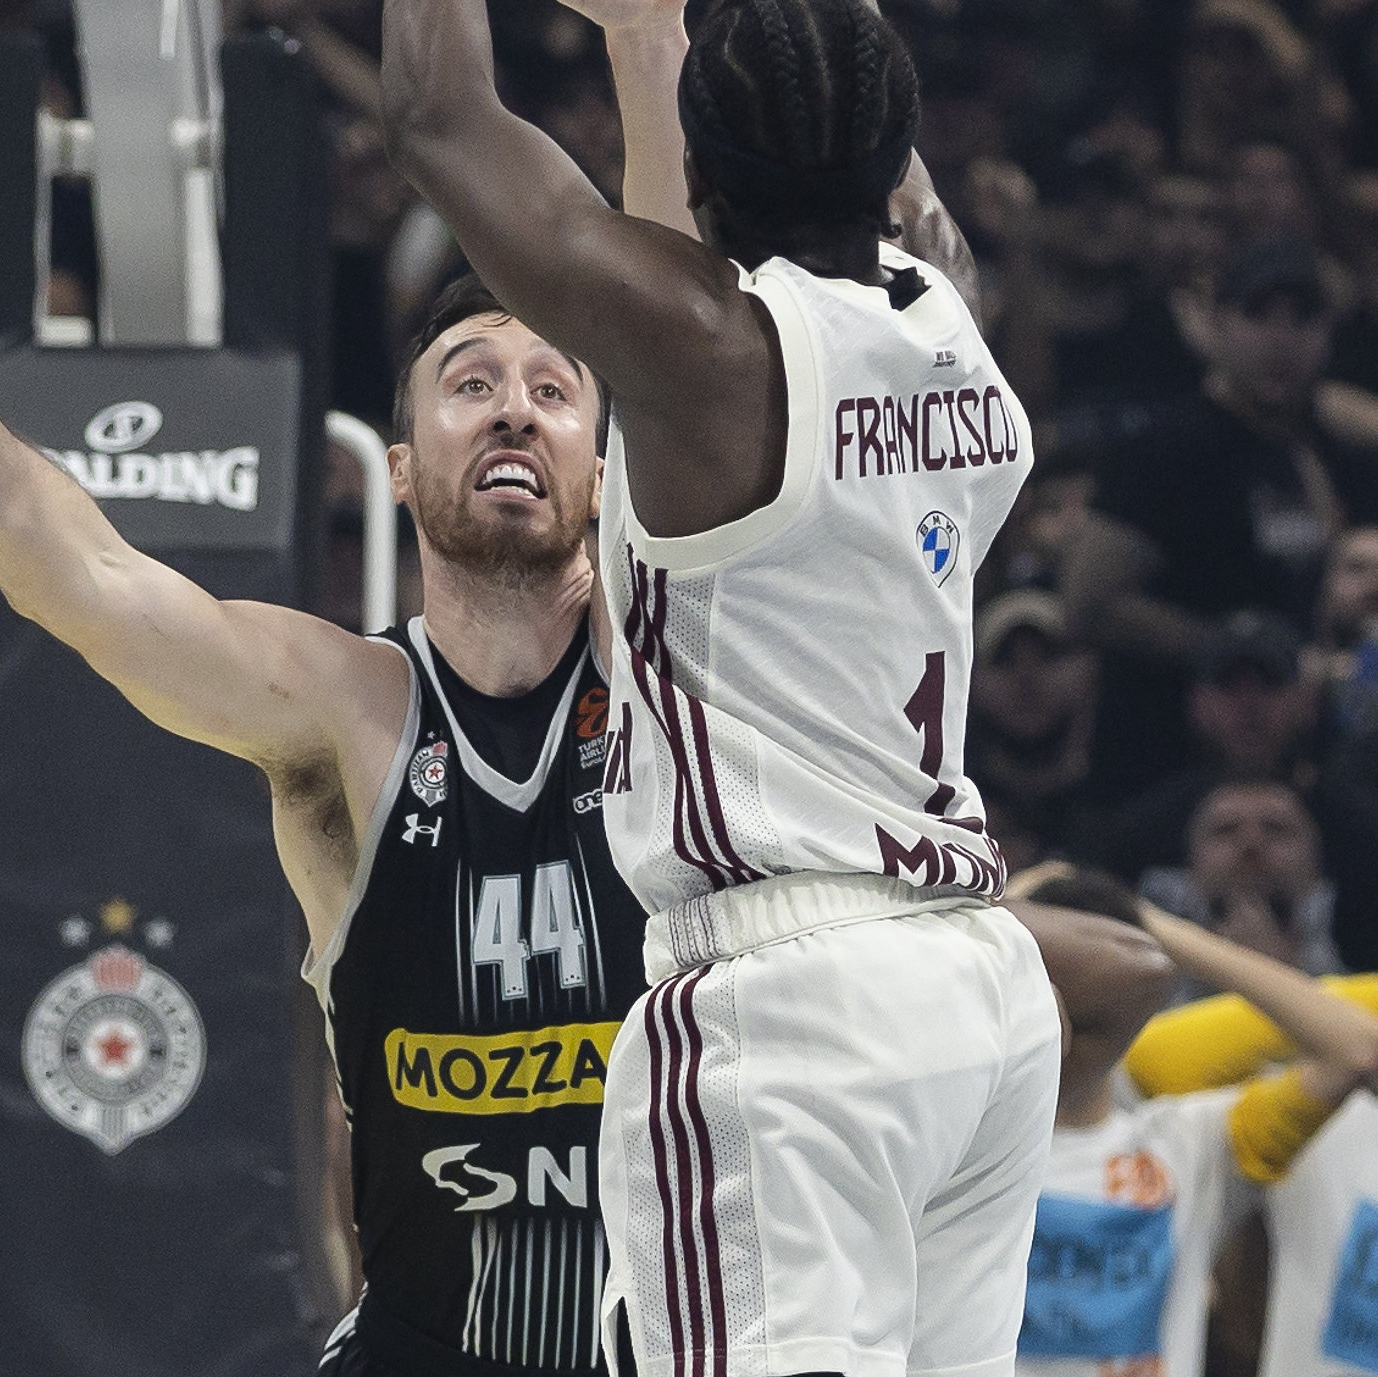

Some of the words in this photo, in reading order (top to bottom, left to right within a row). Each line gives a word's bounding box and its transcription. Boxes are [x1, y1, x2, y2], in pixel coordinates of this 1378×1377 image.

[835, 385, 1018, 480] FRANCISCO
[578, 735, 606, 753] TURK
[903, 651, 983, 835] 1
[472, 859, 586, 1000] 44
[396, 1039, 607, 1100] MOZZA
